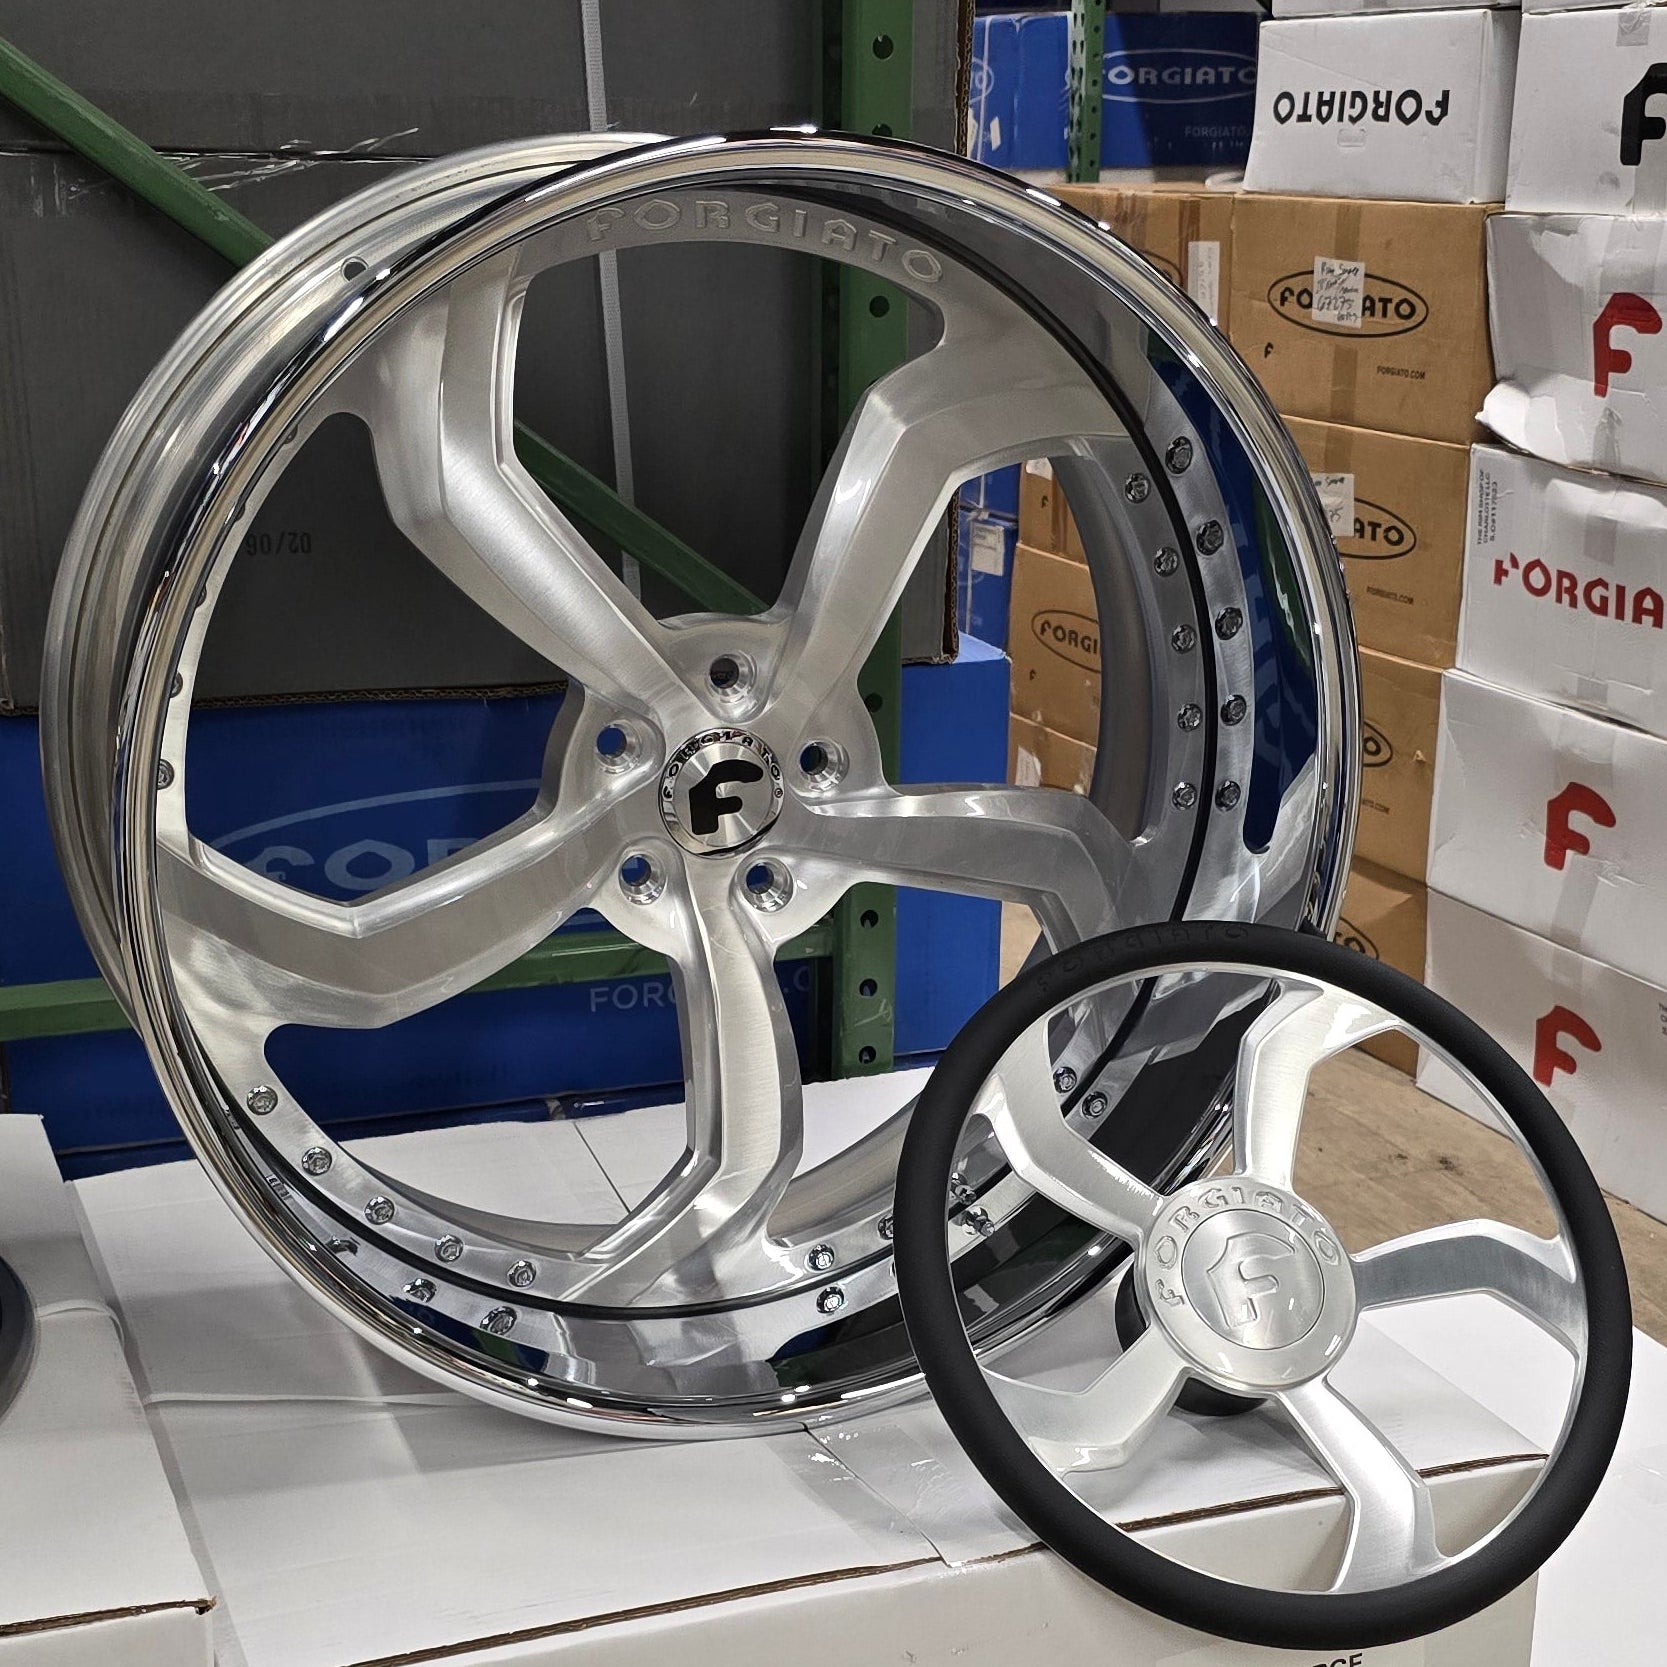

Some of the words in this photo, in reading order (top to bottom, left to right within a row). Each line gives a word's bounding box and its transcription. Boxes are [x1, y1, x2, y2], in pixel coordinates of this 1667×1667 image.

[1102, 66, 1256, 86] ORGIATO
[1272, 89, 1450, 126] FORGIATO
[586, 199, 943, 283] FORGIATO
[1279, 286, 1416, 321] FOATO
[1263, 342, 1274, 358] F
[1593, 292, 1662, 398] F
[689, 759, 764, 836] F
[1543, 782, 1617, 871] F
[1533, 1005, 1602, 1087] F
[1154, 1187, 1341, 1306] FORGIATO
[1206, 1231, 1296, 1330] F
